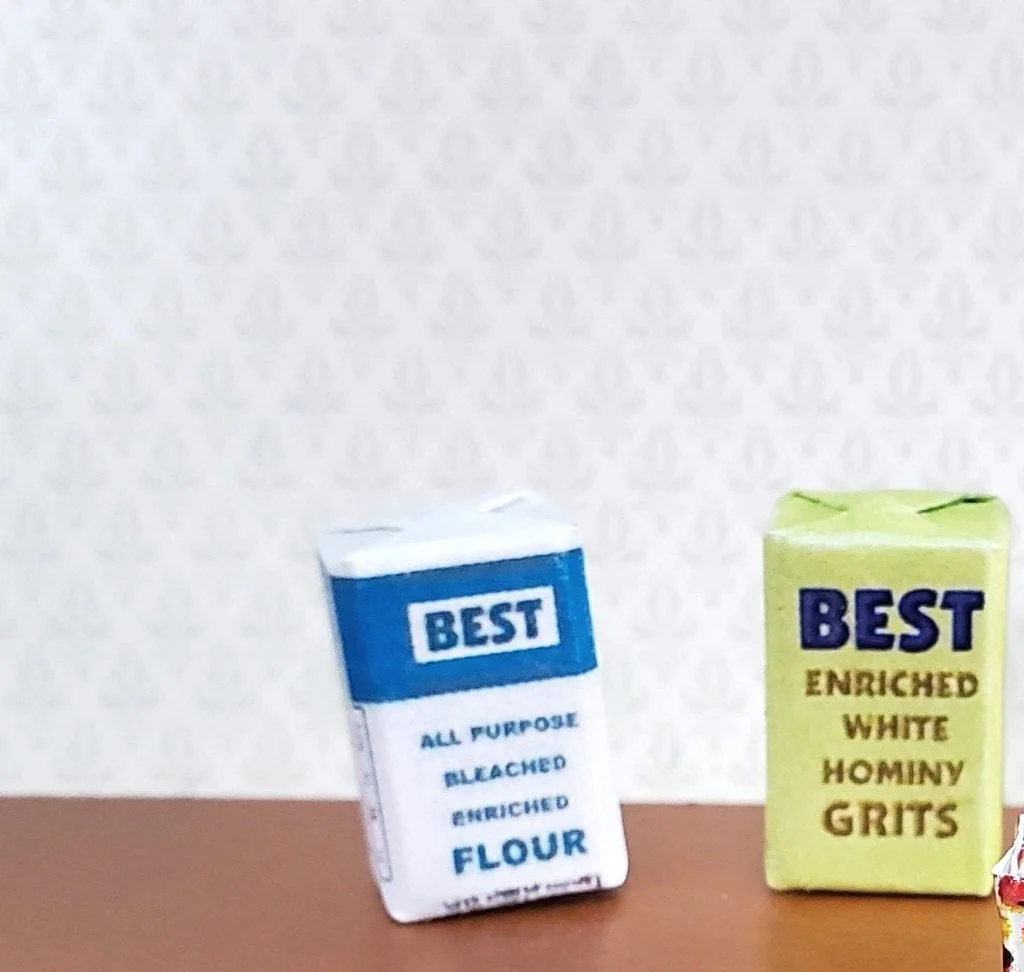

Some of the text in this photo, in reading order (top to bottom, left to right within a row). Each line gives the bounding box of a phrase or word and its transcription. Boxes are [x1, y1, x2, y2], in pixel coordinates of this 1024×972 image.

[424, 598, 543, 652] BEST
[799, 587, 986, 653] BEST
[804, 669, 979, 699] ENRICHED
[420, 712, 579, 751] ALL PURPOSE
[842, 713, 950, 743] WHITE
[443, 753, 567, 789] BLEACHED
[821, 758, 966, 787] HOMINY
[451, 794, 570, 827] ENRICHED
[821, 800, 960, 840] GRITS
[451, 828, 589, 875] FLOUR
